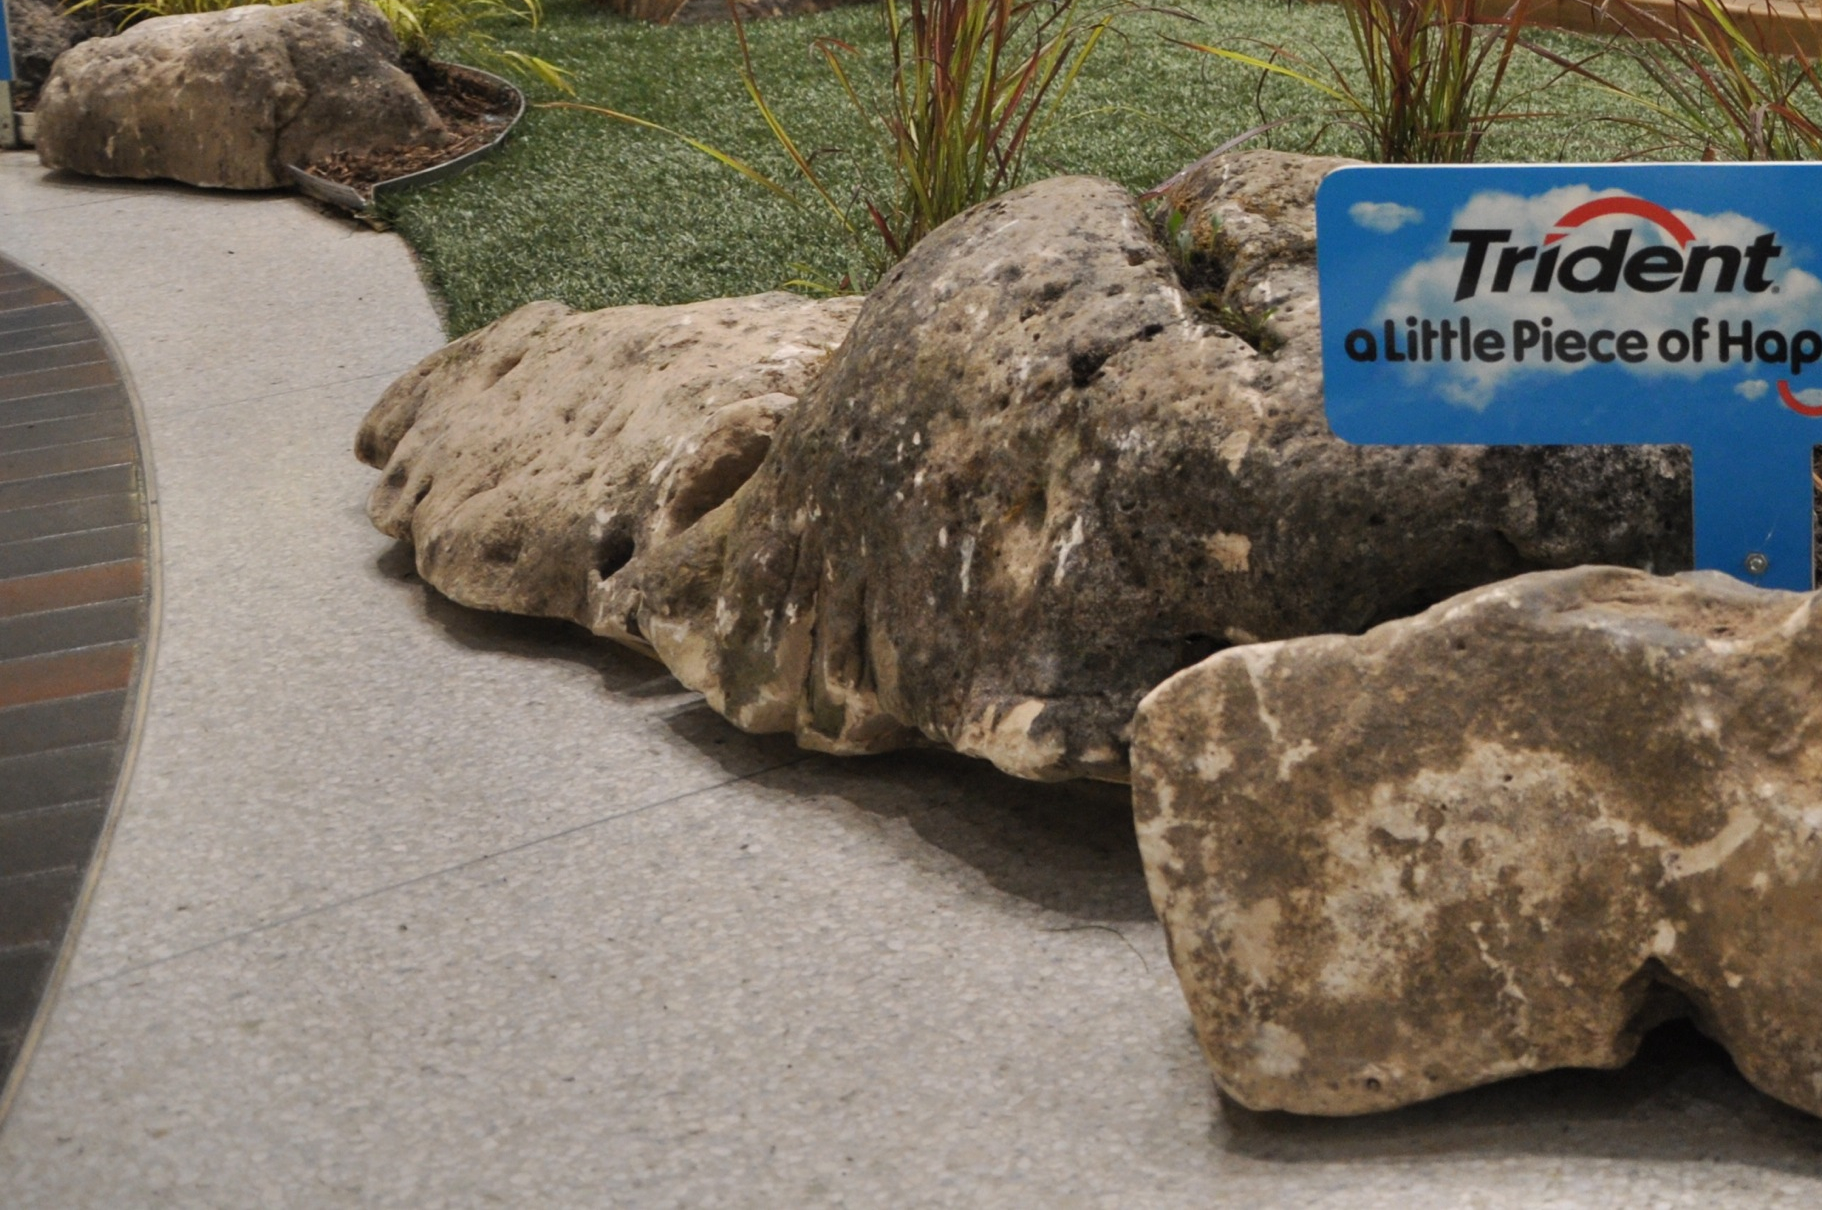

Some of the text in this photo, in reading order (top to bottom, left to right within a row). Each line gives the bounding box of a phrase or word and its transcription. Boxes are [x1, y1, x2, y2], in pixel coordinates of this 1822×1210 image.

[1449, 228, 1782, 302] Trident
[1344, 326, 1377, 364] a
[1384, 316, 1506, 364] Little
[1512, 316, 1648, 364] Piece
[1658, 316, 1710, 364] of
